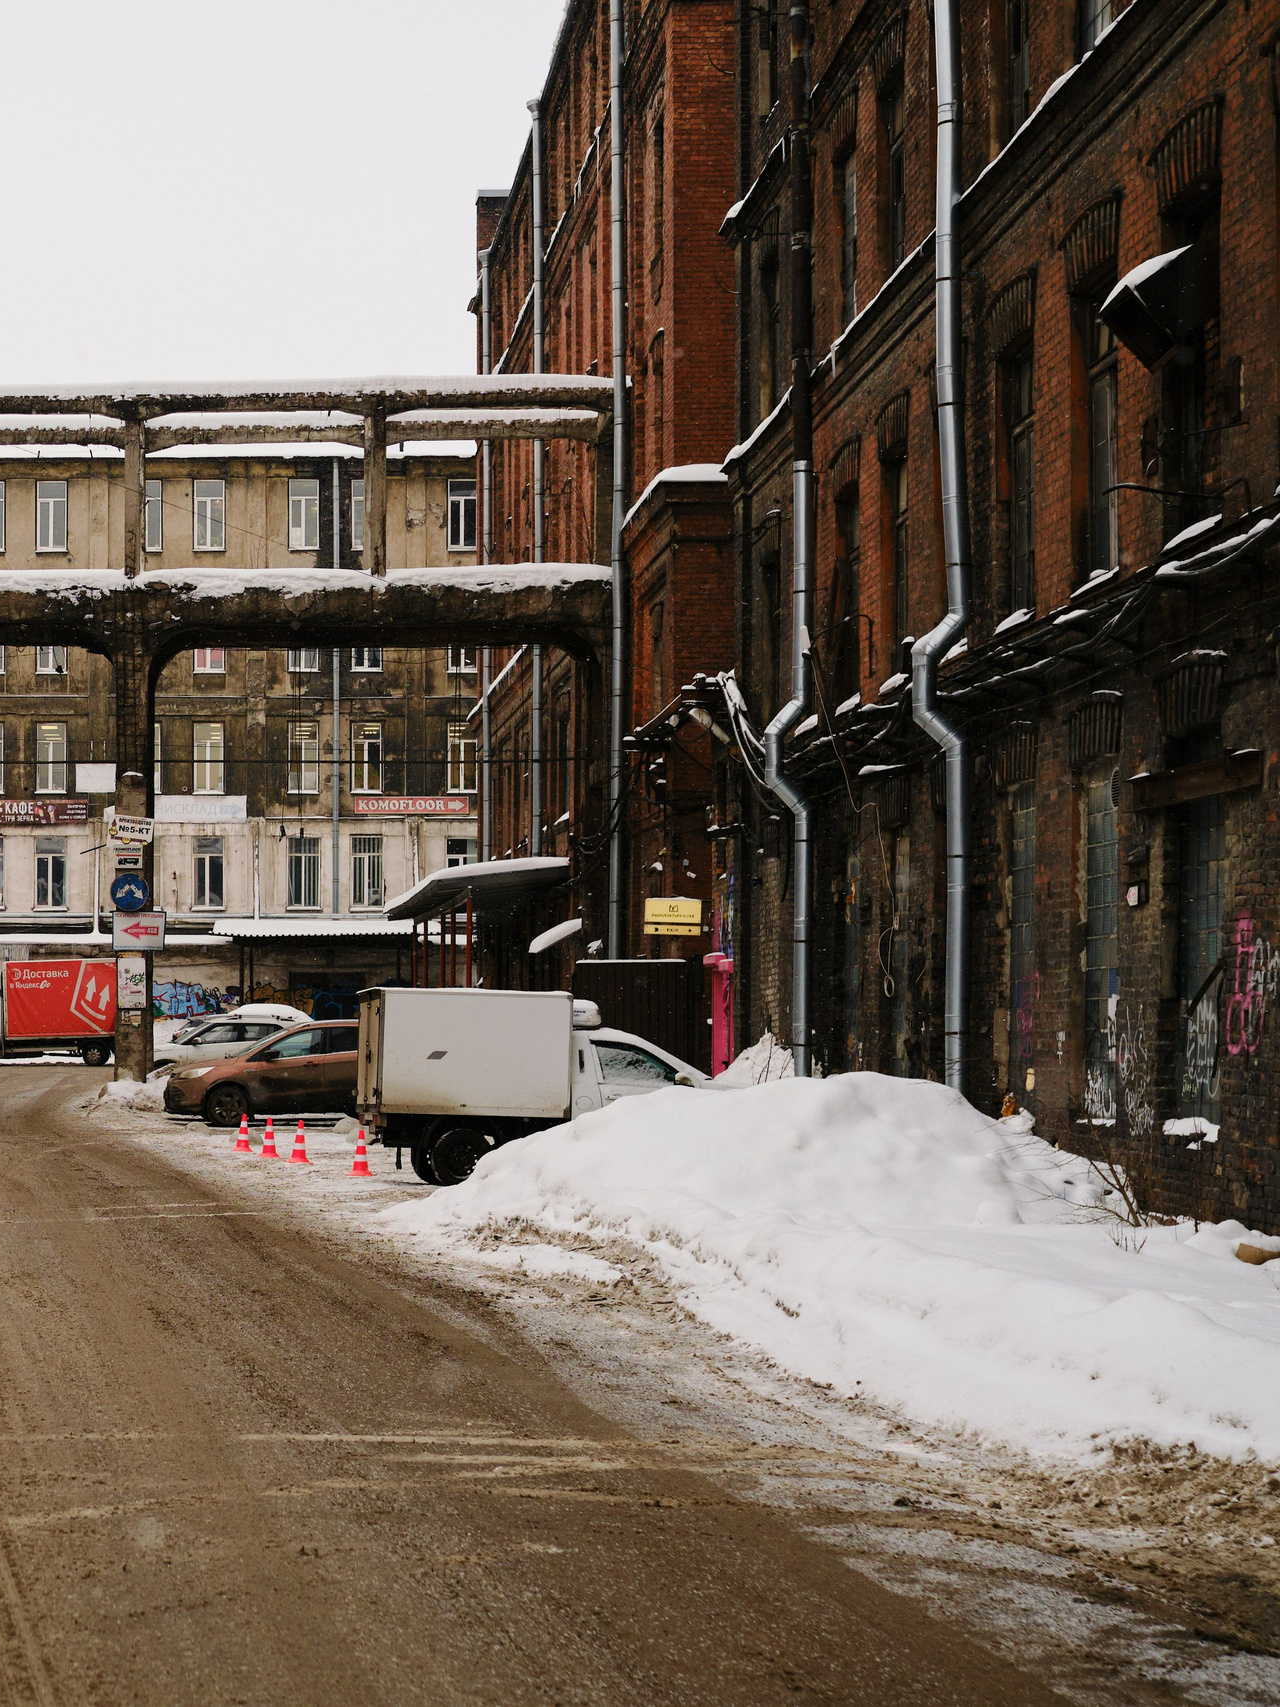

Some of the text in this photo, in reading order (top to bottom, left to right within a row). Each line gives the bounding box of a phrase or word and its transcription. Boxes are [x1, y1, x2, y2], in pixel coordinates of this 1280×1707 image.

[4, 801, 35, 815] КАФЕ
[358, 800, 445, 811] KOMOFLOOR
[4, 814, 35, 822] ТРИ ЗЕРНА
[23, 969, 69, 980] Доставка
